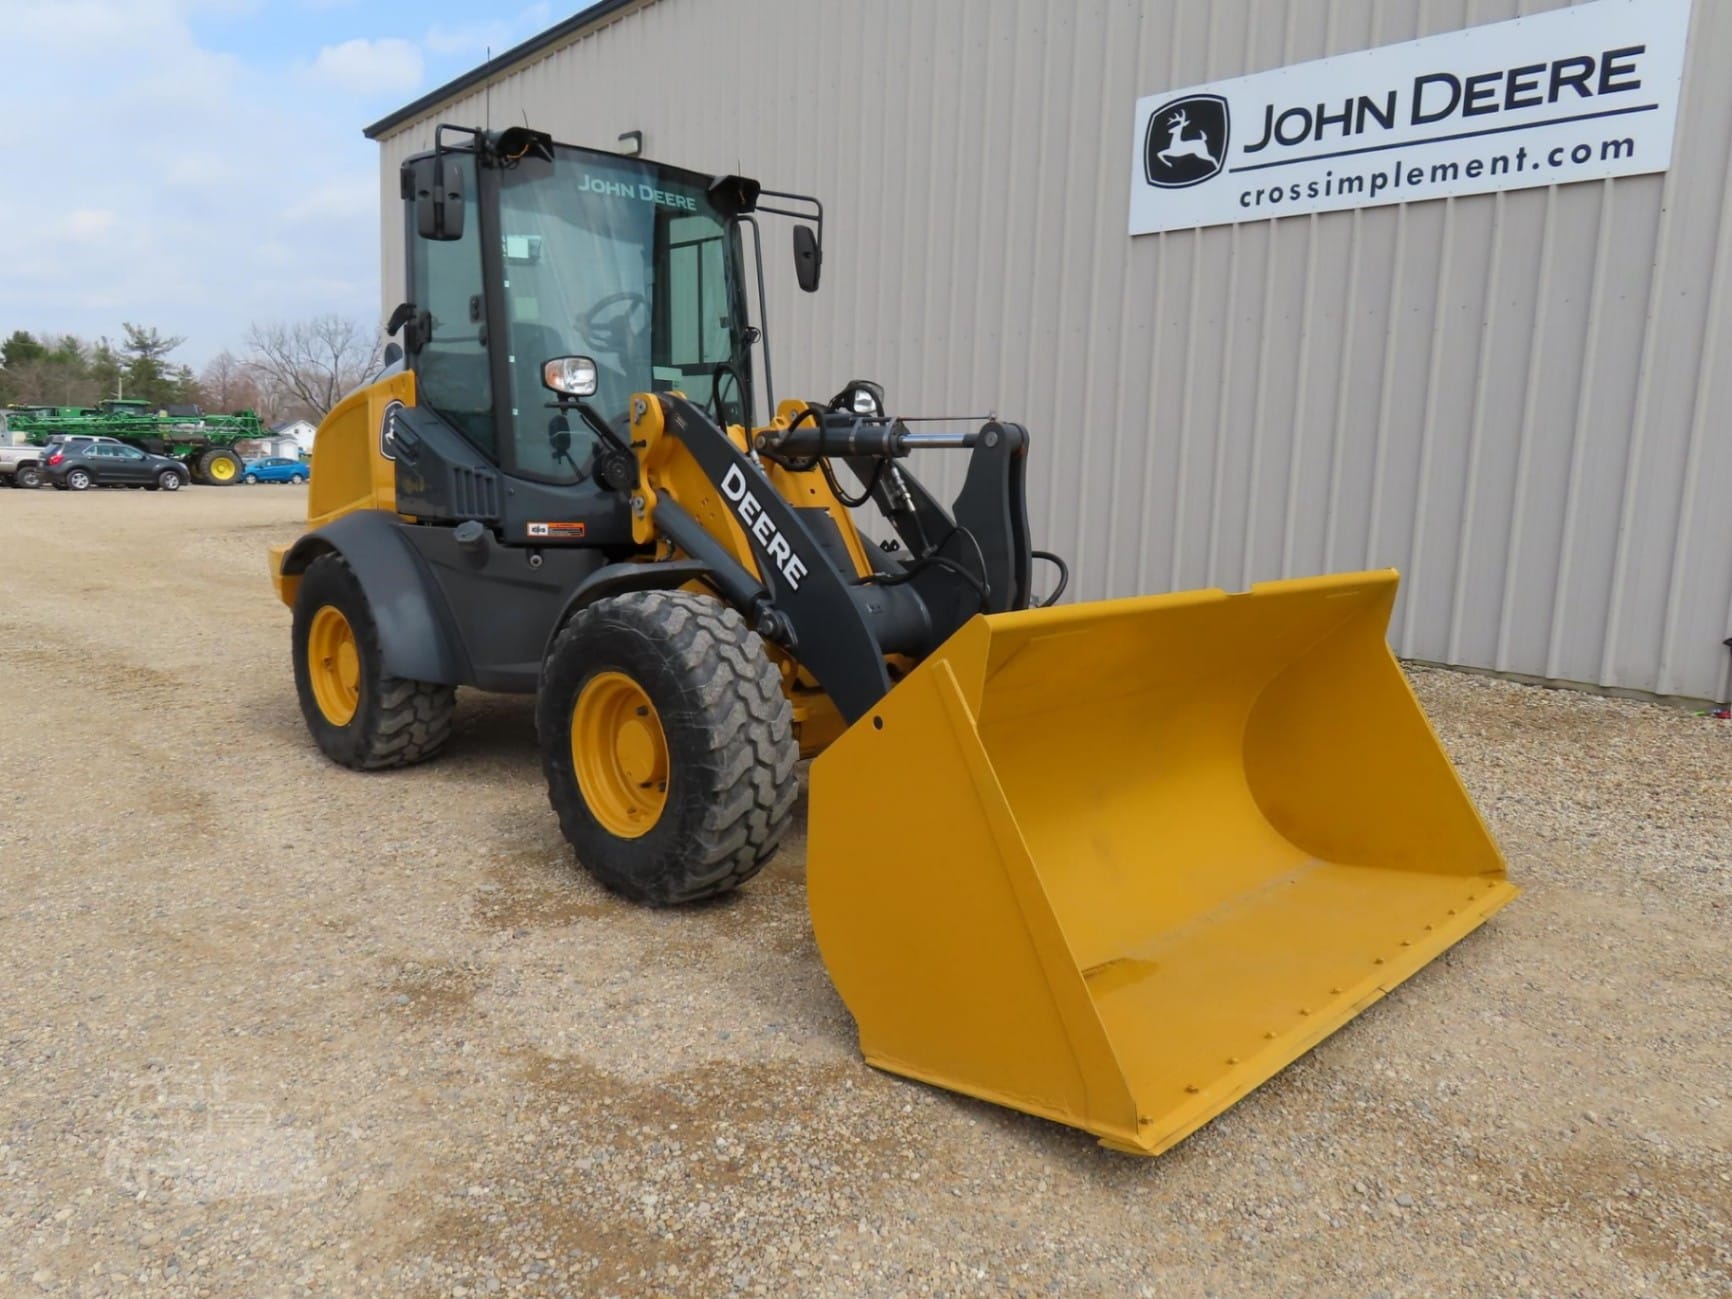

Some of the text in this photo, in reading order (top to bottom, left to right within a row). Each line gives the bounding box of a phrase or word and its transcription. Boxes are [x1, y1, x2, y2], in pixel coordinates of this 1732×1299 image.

[1244, 45, 1646, 153] JOHN DEERE
[578, 174, 697, 211] JOHN DEERE
[1240, 138, 1634, 207] crossimplement.com
[721, 462, 808, 591] DEERE
